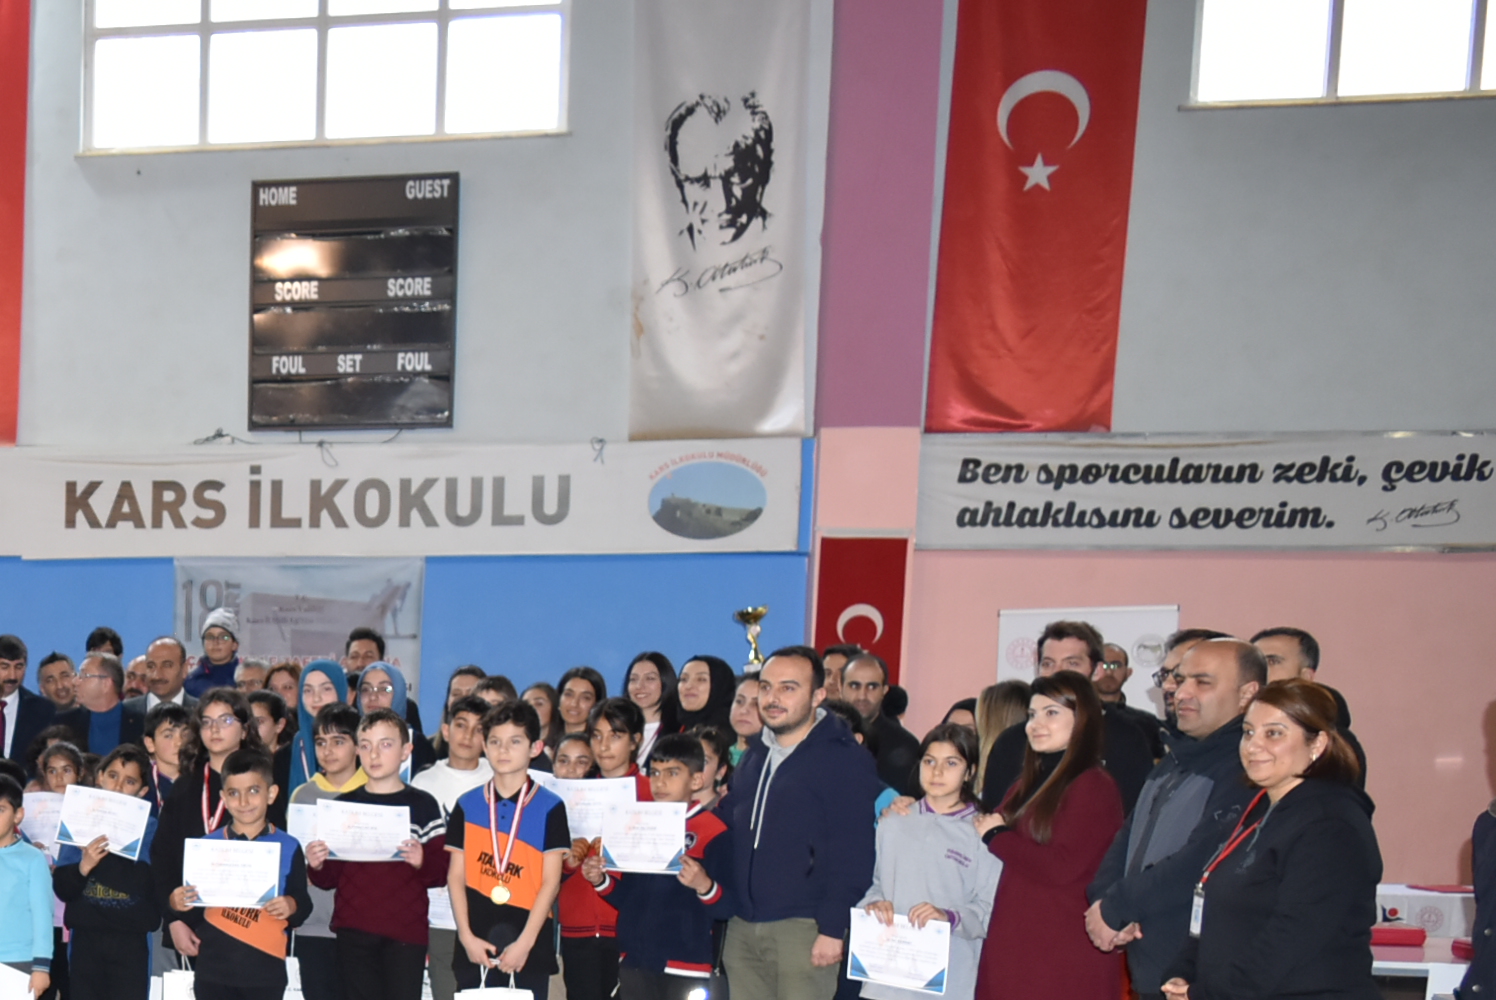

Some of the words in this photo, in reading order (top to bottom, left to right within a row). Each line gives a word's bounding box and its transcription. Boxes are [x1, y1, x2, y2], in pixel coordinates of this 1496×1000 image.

[259, 186, 298, 206] HOME
[405, 179, 451, 200] GUEST
[274, 280, 319, 301] SCORE
[387, 277, 432, 297] SCORE
[271, 355, 306, 375] FOUL
[337, 353, 363, 373] SET
[397, 352, 432, 372] FOUL
[957, 457, 1030, 484] Ben
[1036, 456, 1264, 491] sporcuların
[1272, 454, 1368, 487] zeki,
[1381, 453, 1495, 493] çevik
[64, 479, 227, 529] KARS
[248, 465, 572, 529] İLKOKULU
[956, 501, 1162, 529] ahlaklısını
[1168, 500, 1335, 530] severim.
